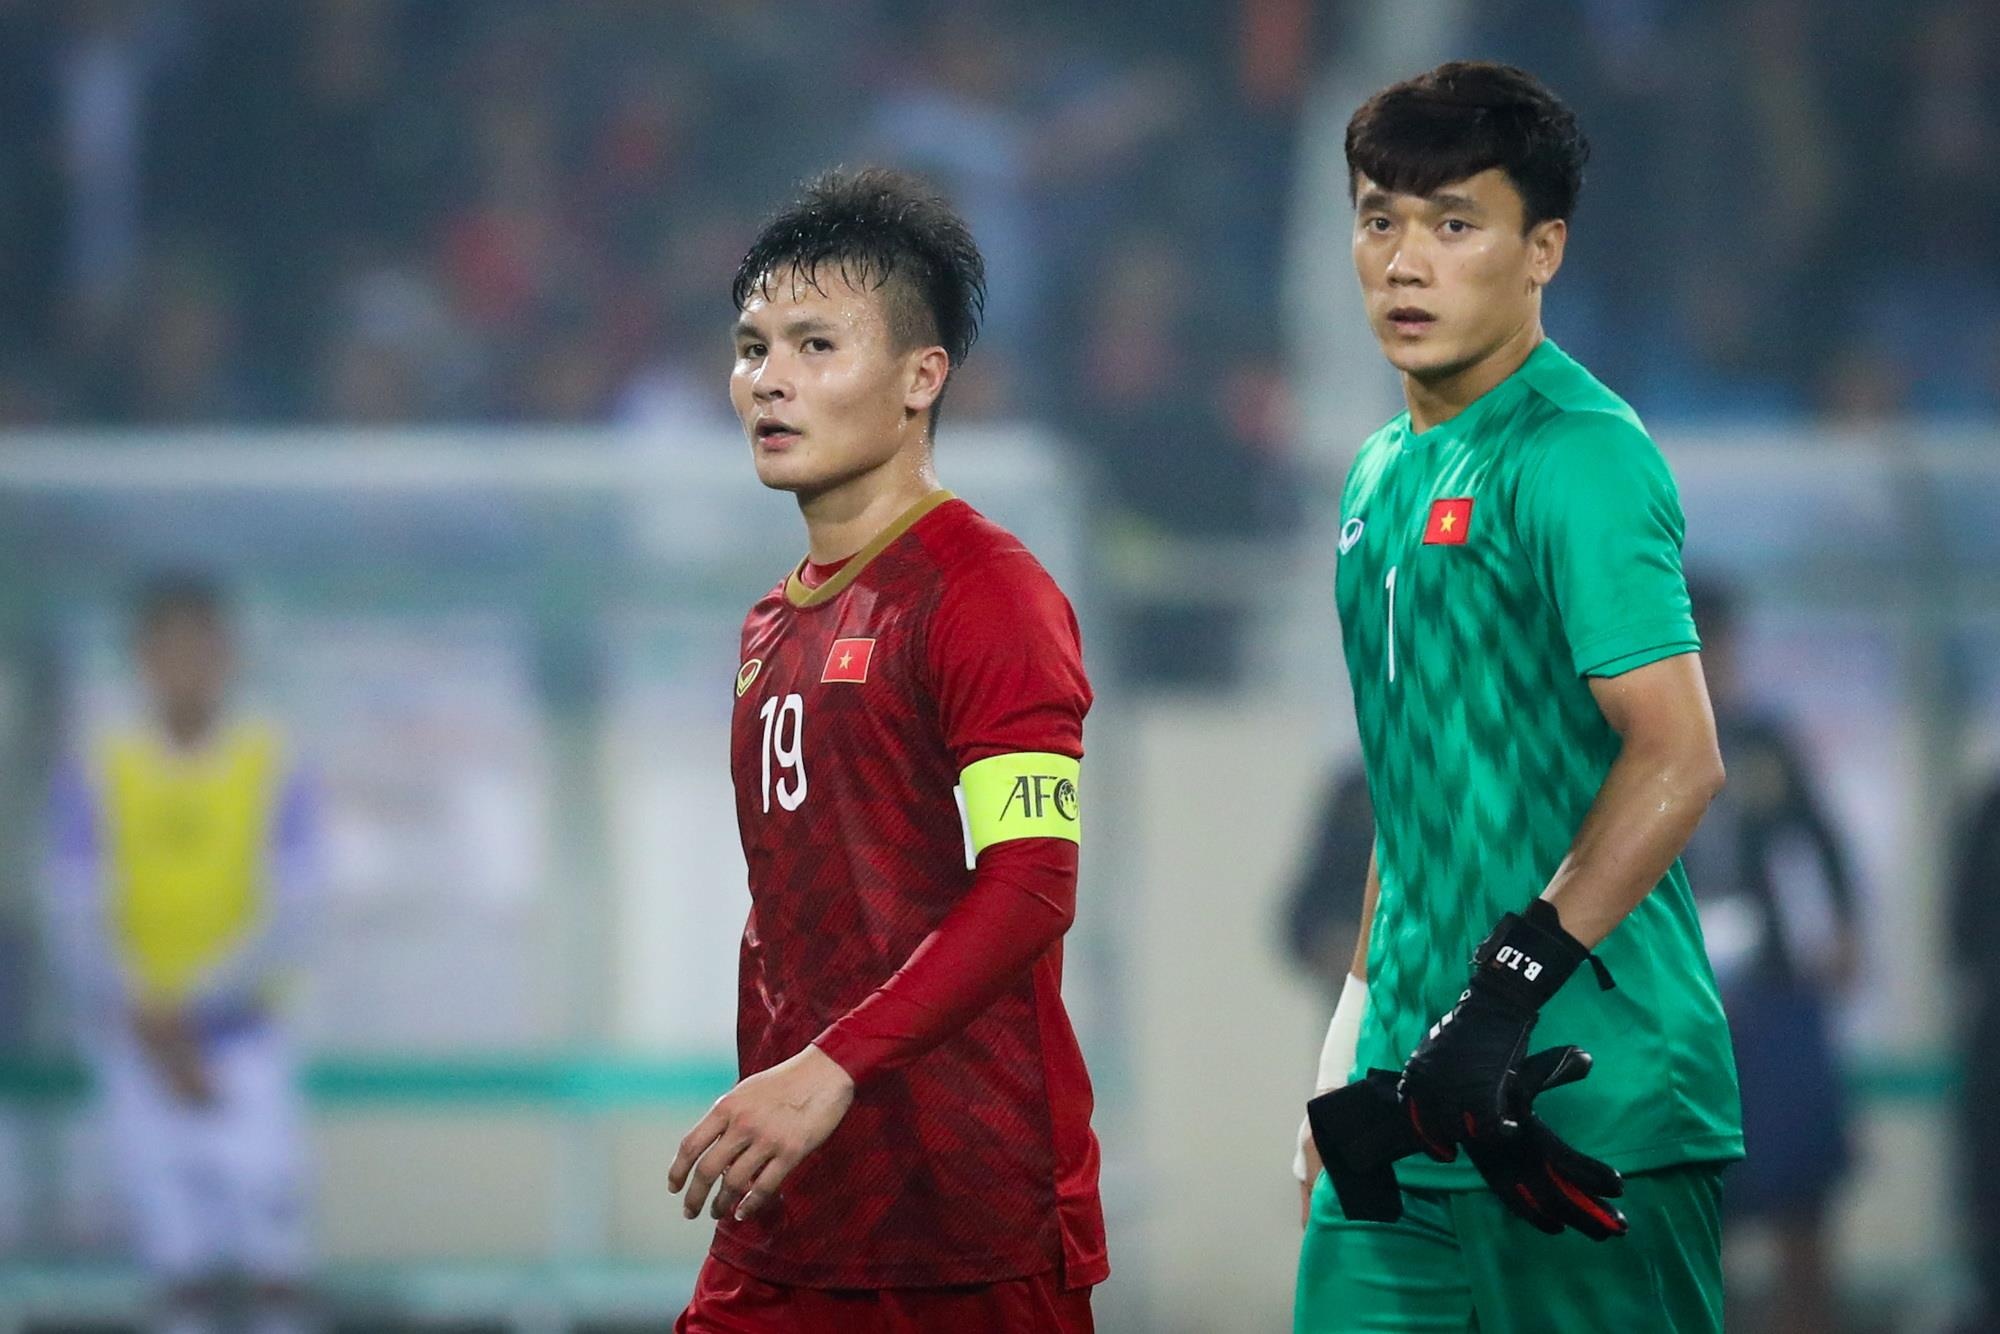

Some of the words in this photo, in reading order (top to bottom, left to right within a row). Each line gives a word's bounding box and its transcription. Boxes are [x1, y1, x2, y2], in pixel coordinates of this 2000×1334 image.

[1385, 566, 1397, 683] 1
[759, 693, 807, 814] 19
[998, 775, 1079, 822] AFC
[1496, 945, 1543, 982] B.T.D
